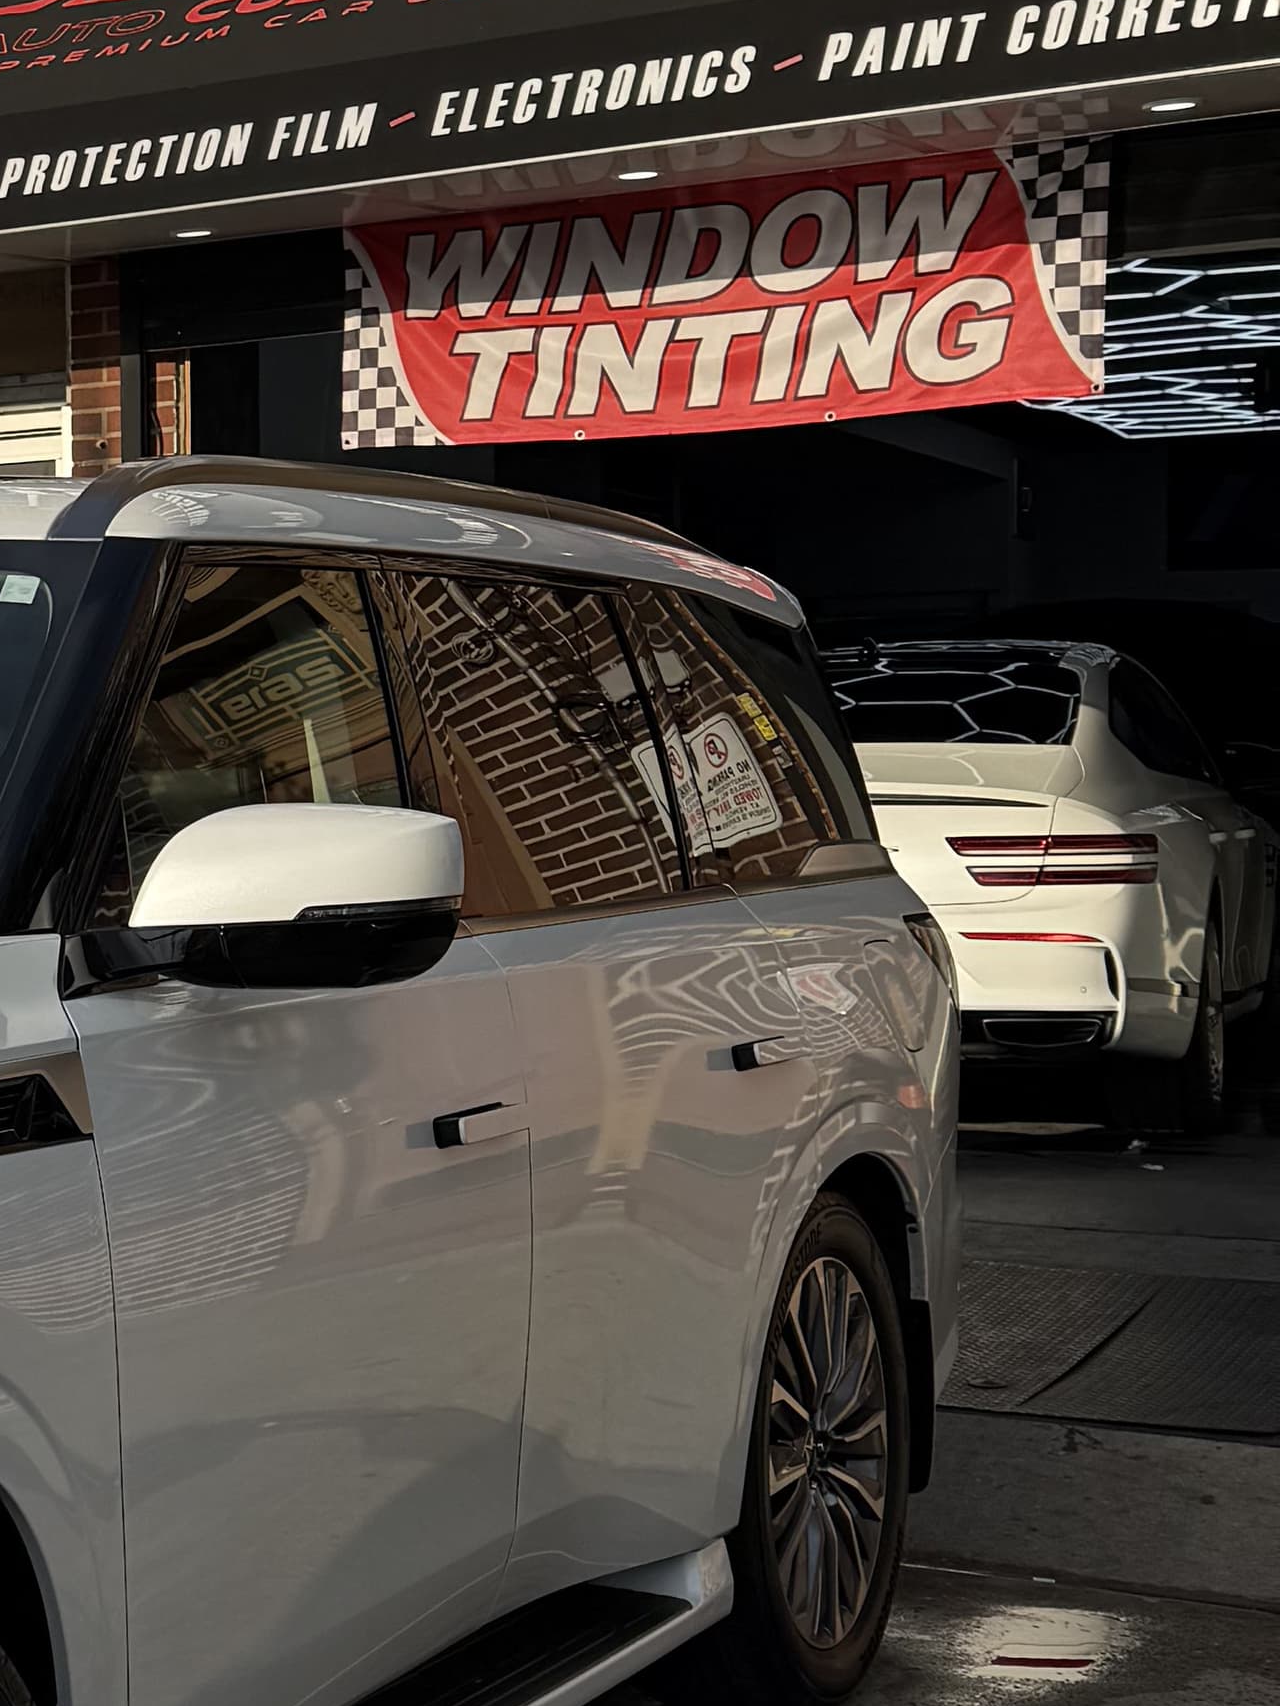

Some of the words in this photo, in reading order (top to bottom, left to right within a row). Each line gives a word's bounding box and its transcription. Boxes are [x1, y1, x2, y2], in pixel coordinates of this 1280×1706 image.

[263, 0, 374, 29] CAR
[266, 101, 379, 161] FILM
[430, 43, 758, 138] ELECTRONICS
[817, 11, 987, 82] PAINT
[401, 168, 1000, 322] WINDOW
[447, 274, 1016, 423] TINTING
